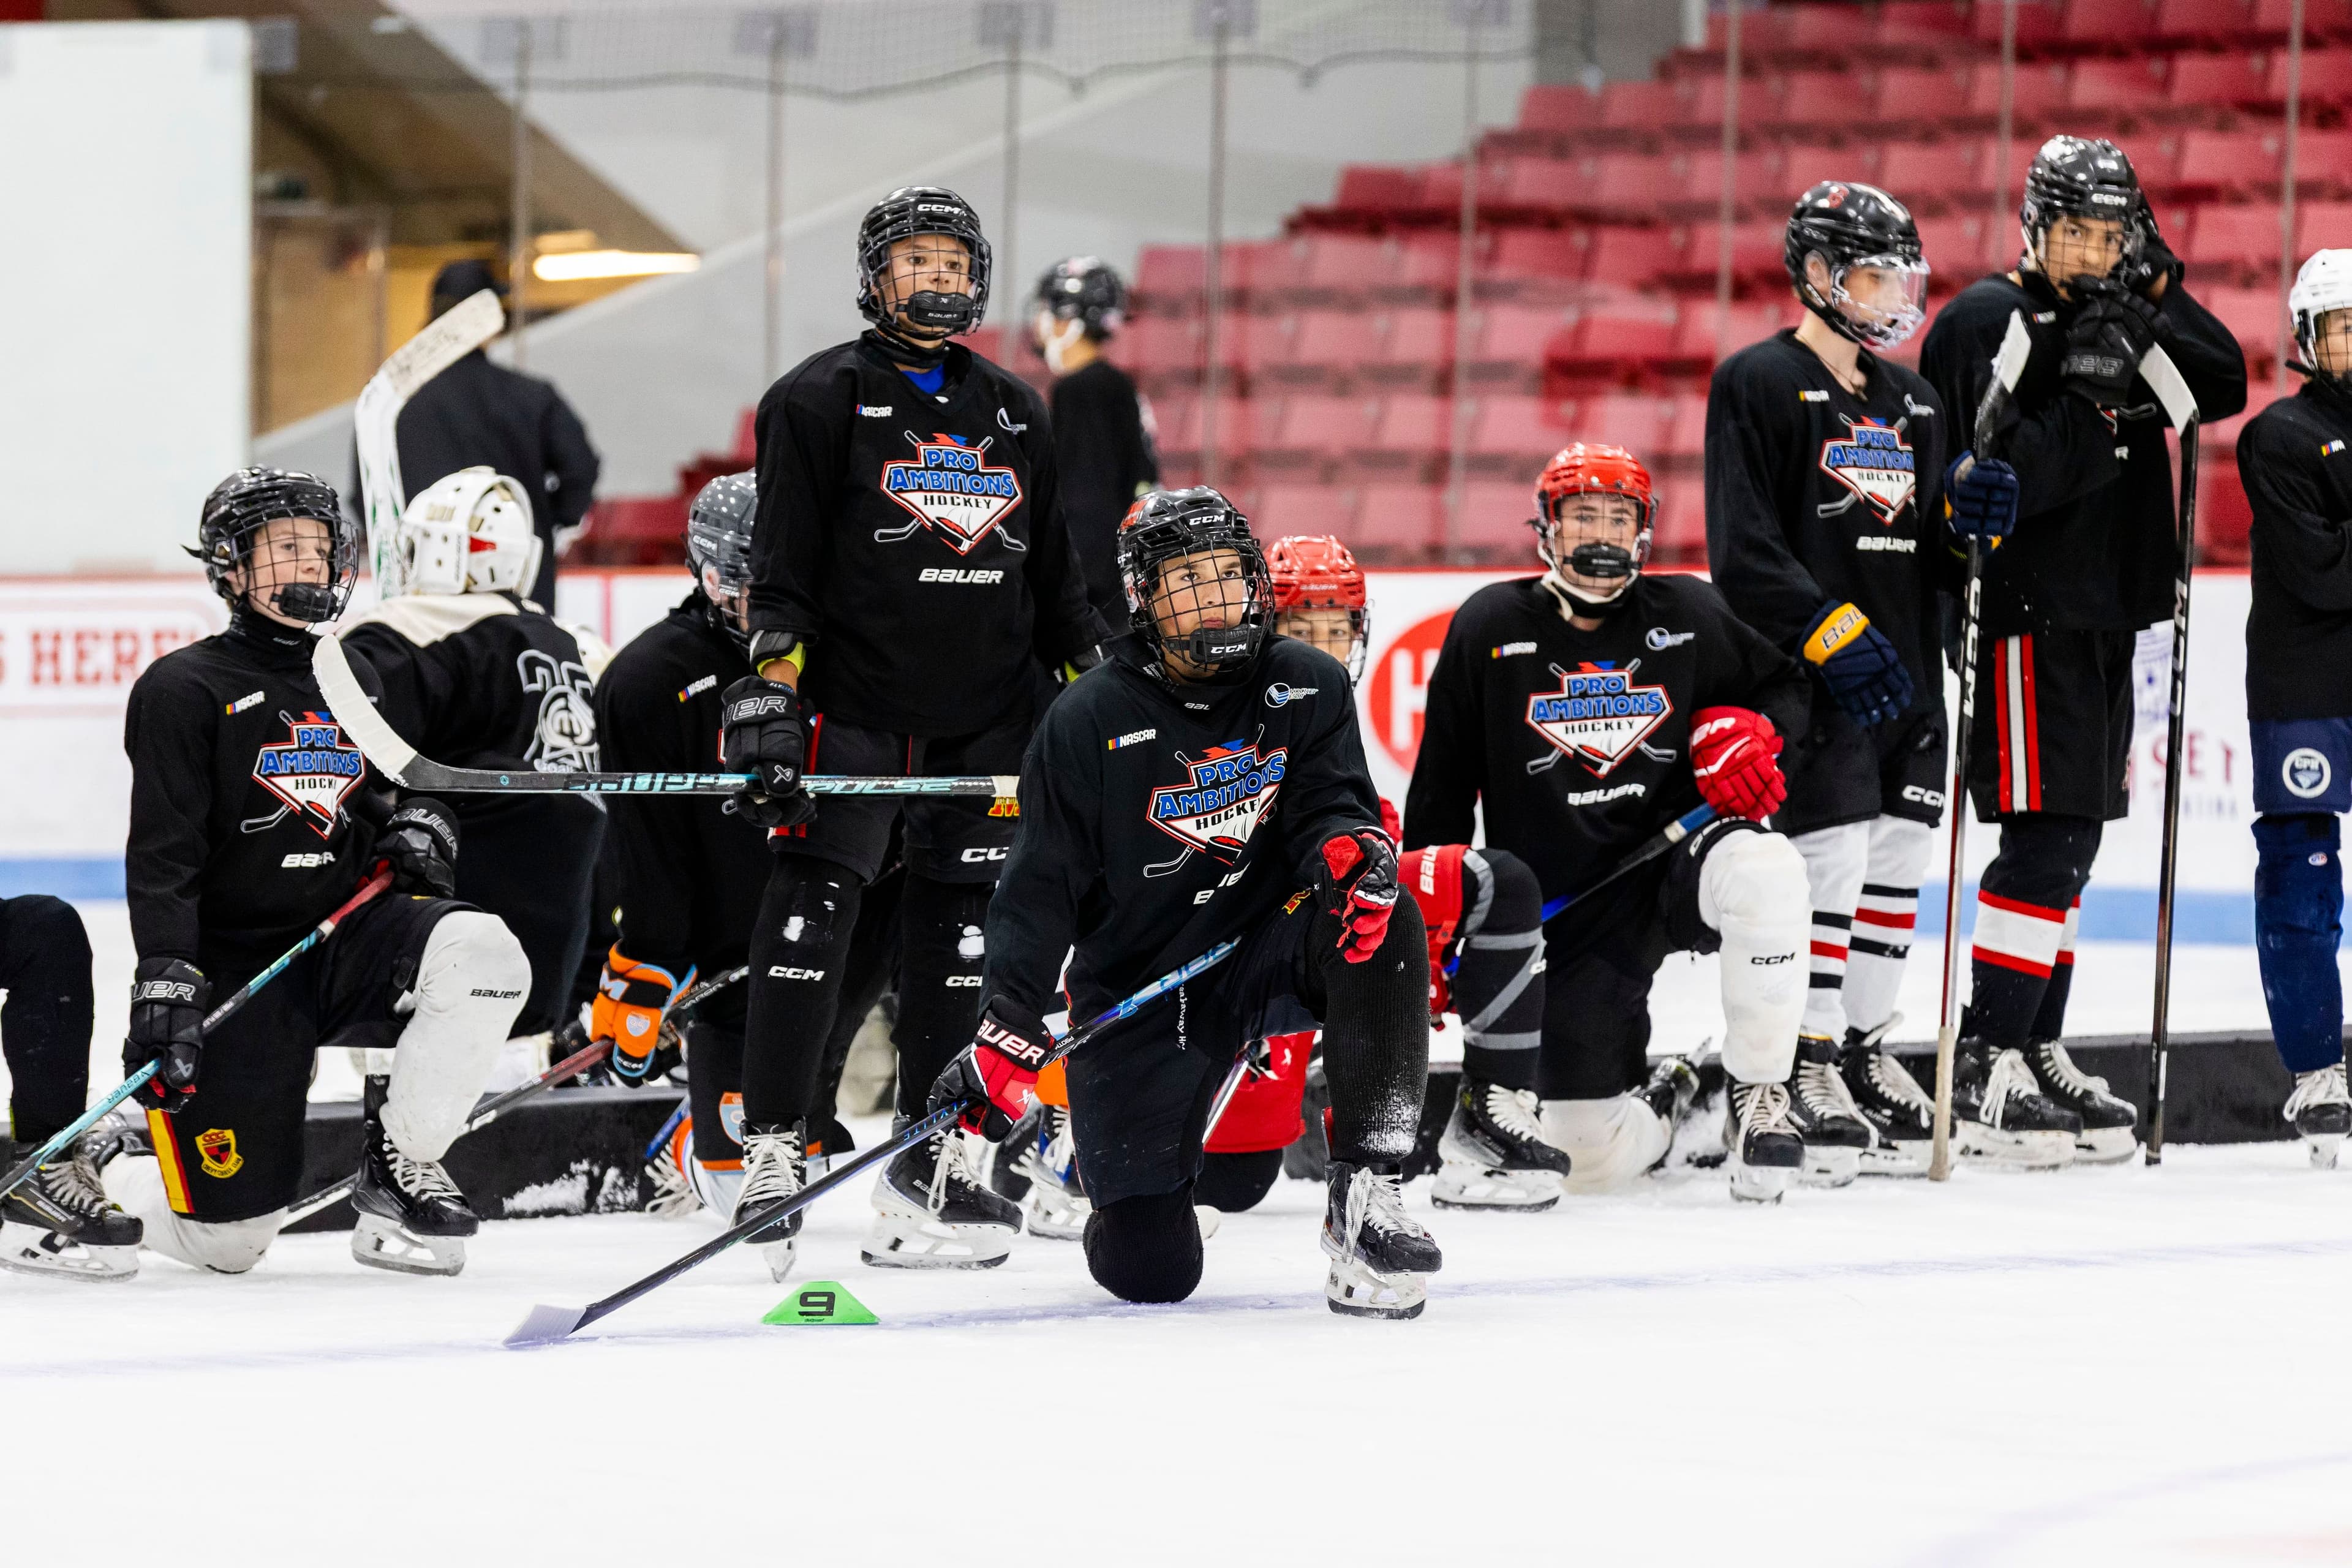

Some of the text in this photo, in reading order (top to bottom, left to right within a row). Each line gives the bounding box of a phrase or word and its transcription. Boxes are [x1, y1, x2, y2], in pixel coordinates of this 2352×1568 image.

[1856, 430, 1896, 449] PRO
[924, 448, 976, 470] PRO
[889, 467, 1014, 496] AMBITIONS
[924, 494, 992, 510] HOCKEY
[1189, 515, 1225, 526] CCM
[919, 568, 1005, 584] BAUER
[1211, 643, 1246, 654] CCM
[1569, 676, 1624, 696] PRO
[1533, 692, 1664, 722] AMBITIONS
[1565, 720, 1634, 734] HOCKEY
[1114, 729, 1156, 748] NASCAR
[1199, 755, 1254, 787] PRO
[1196, 798, 1261, 831] HOCKE
[1751, 952, 1796, 965] CCM
[768, 965, 825, 981] CCM
[469, 989, 522, 999] BAUER
[1177, 984, 1187, 1034] eakaway
[798, 1292, 835, 1316] 9
